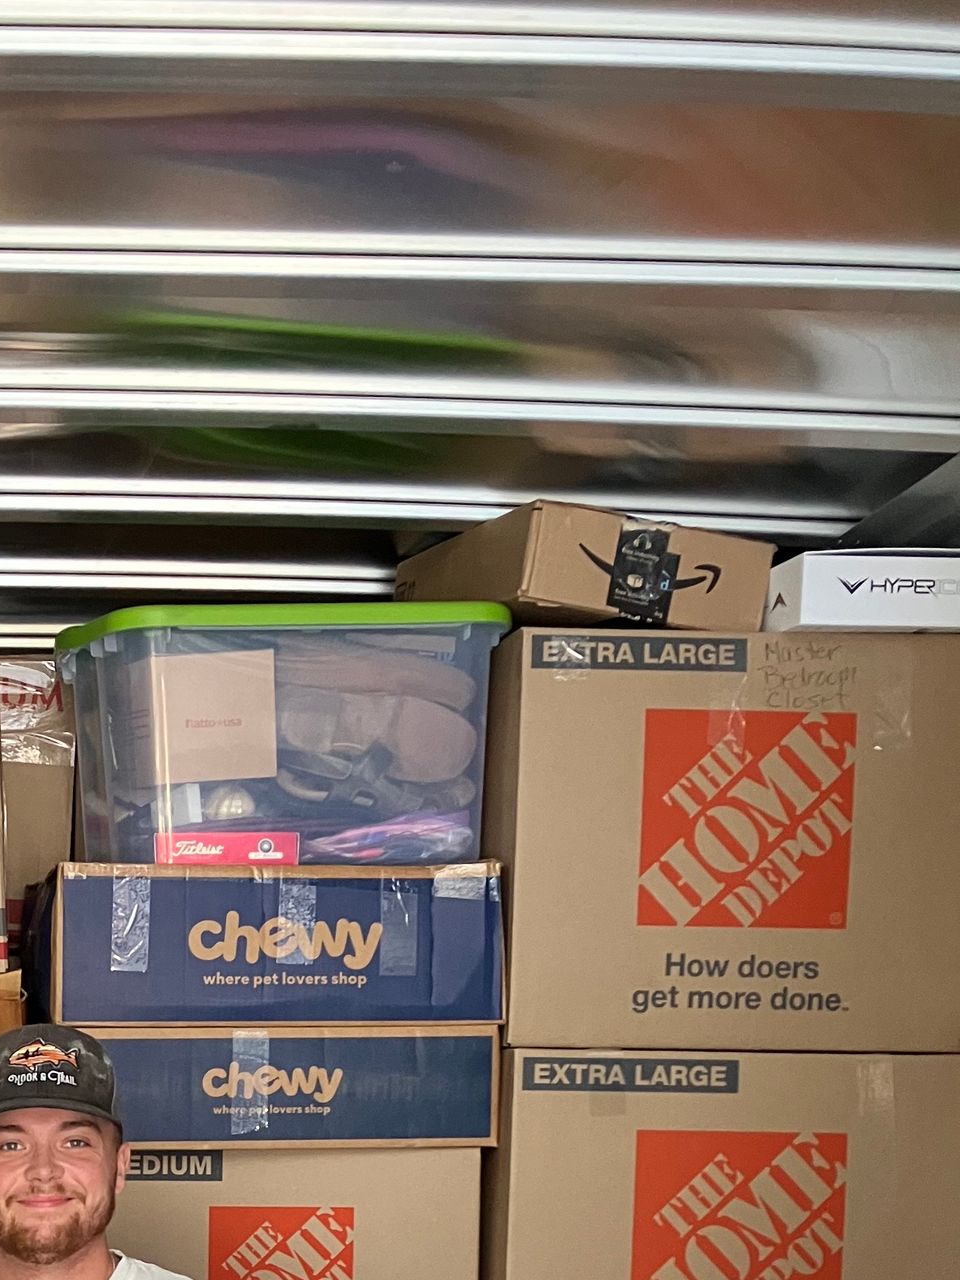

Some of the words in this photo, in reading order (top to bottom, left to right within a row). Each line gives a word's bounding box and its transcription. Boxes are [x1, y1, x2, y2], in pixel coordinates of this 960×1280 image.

[543, 641, 634, 663] EXTRA
[643, 643, 735, 665] LARGE
[663, 732, 753, 818] THE
[638, 709, 858, 927] HOME
[172, 841, 224, 856] Titleist
[721, 793, 852, 928] DEPOT
[188, 910, 384, 970] chewy
[664, 953, 729, 977] How
[737, 954, 819, 979] doers
[203, 972, 250, 985] where
[253, 973, 278, 988] pet
[282, 972, 328, 985] lovers
[331, 972, 367, 988] shop
[632, 987, 678, 1013] get
[687, 991, 761, 1011] more
[202, 1061, 343, 1103] chewy
[534, 1063, 625, 1085] EXTRA
[635, 1065, 727, 1088] LARGE
[269, 1105, 302, 1115] lovers
[304, 1105, 330, 1117] shop
[126, 1156, 212, 1175] EDIUM
[653, 1152, 745, 1238] THE
[222, 1221, 284, 1279] THE
